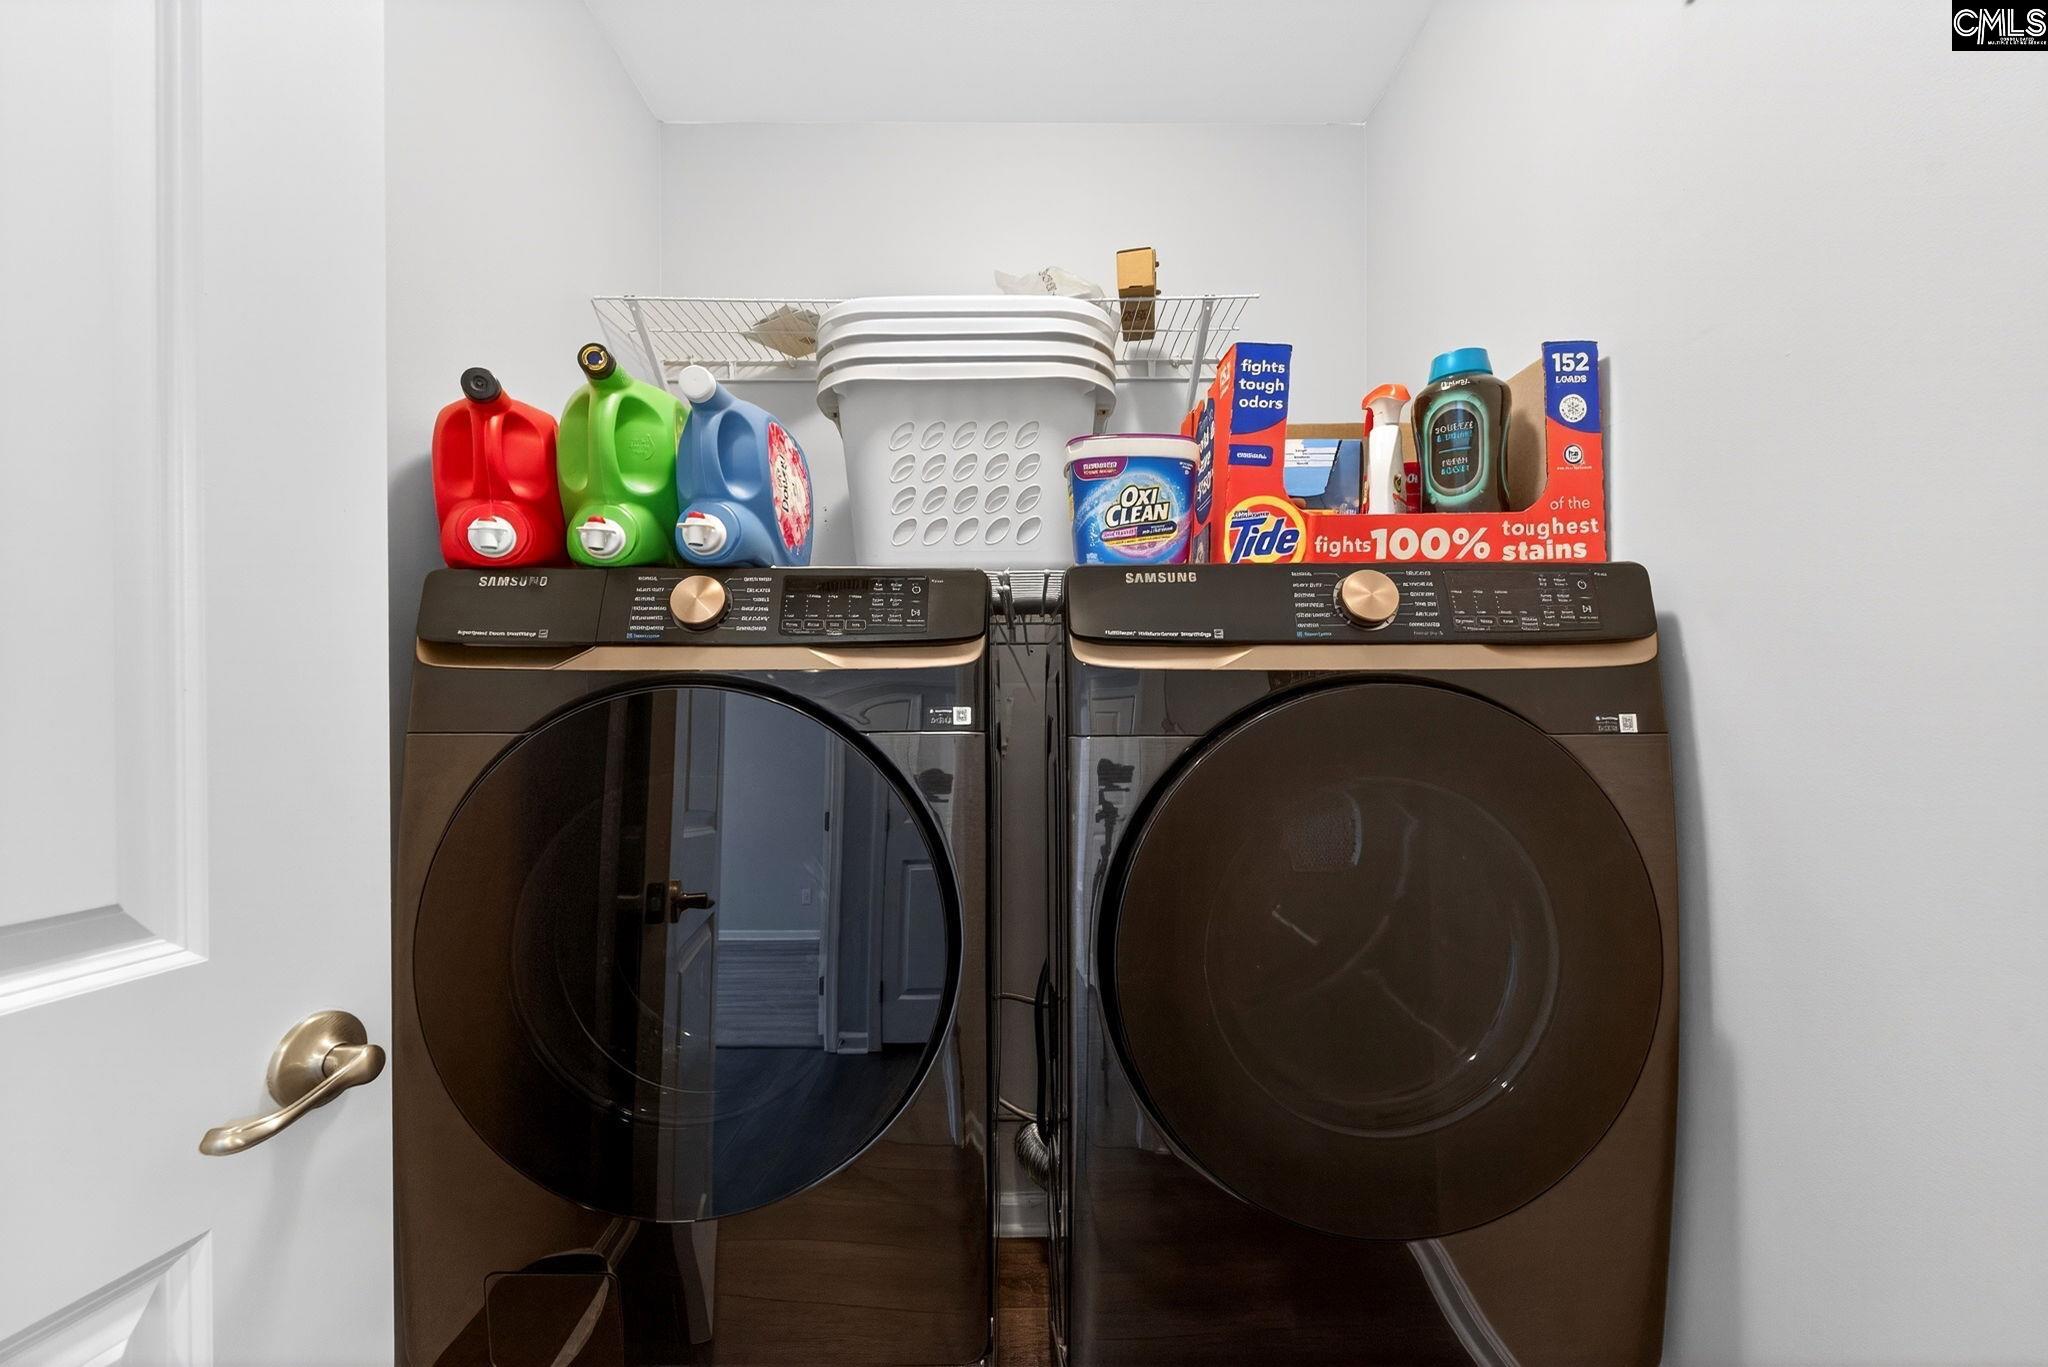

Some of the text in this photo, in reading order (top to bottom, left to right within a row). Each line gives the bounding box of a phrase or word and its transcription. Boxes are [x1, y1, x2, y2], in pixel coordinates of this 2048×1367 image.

[1241, 359, 1285, 375] fights
[1552, 352, 1589, 372] 152
[1239, 378, 1285, 394] tough
[1555, 375, 1587, 383] LOADS
[1239, 395, 1283, 409] odors
[1121, 485, 1159, 508] OXI
[1550, 496, 1591, 510] of the
[1105, 502, 1170, 528] CLEAN
[1502, 517, 1599, 540] toughest
[1230, 517, 1300, 563] Tide
[1314, 527, 1491, 561] fights 100%
[1502, 540, 1588, 561] stains
[1125, 572, 1197, 584] SAMSUNG
